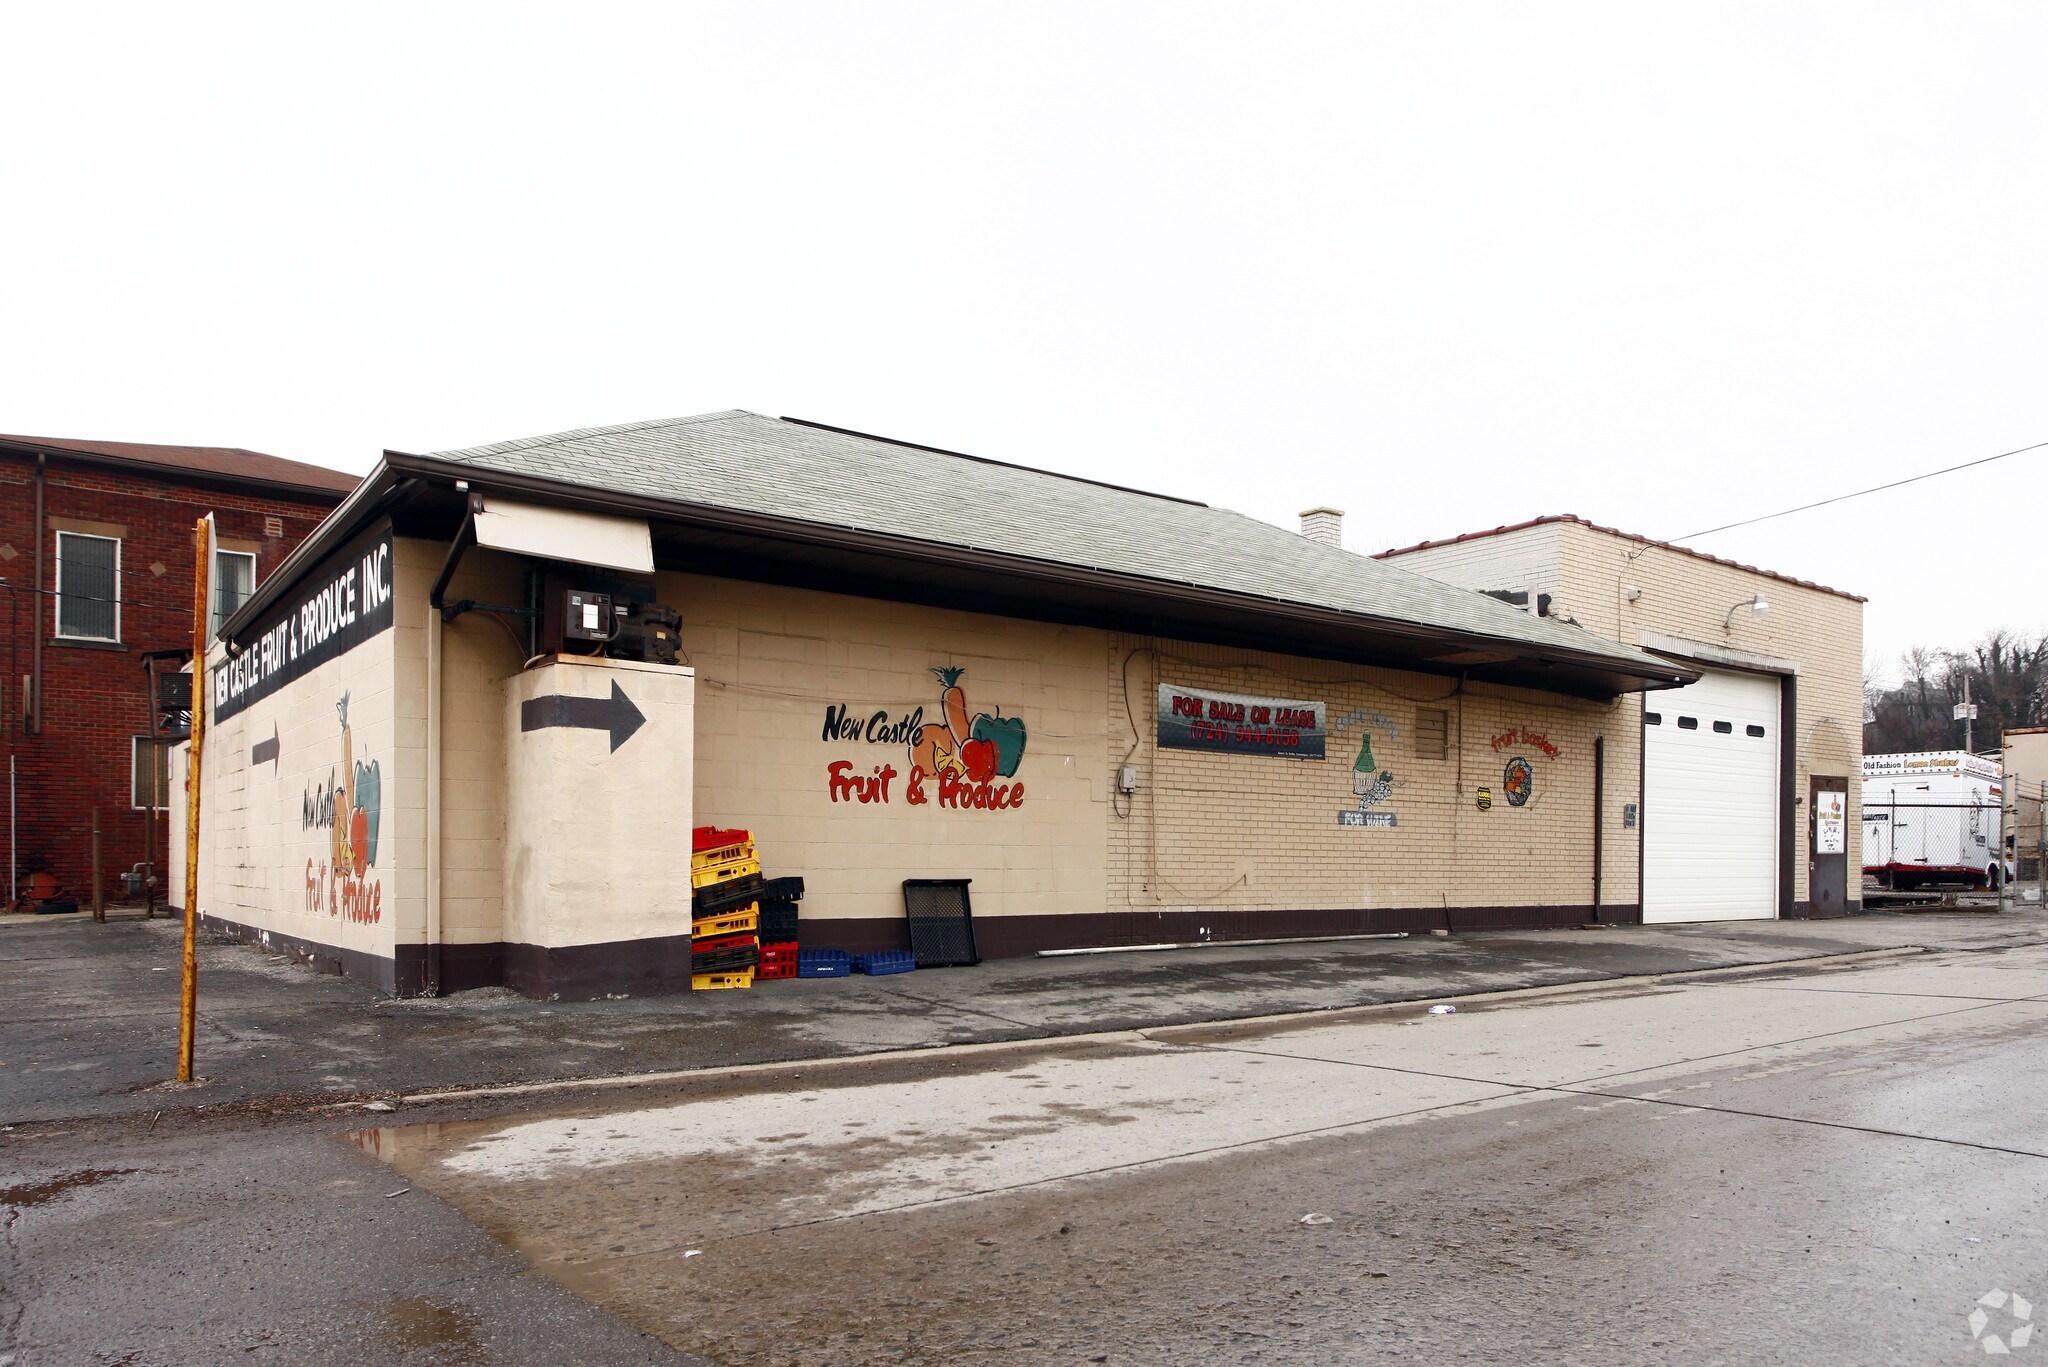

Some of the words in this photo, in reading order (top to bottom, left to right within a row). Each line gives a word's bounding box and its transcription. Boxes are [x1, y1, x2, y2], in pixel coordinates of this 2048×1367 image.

[215, 664, 229, 708] NEW
[229, 641, 258, 698] CASTLE
[261, 619, 288, 680] FRUIT
[290, 612, 298, 661] &
[301, 566, 356, 654] PRODUCE
[362, 542, 391, 615] INC.
[822, 703, 864, 742] New
[865, 706, 924, 747] Castle
[1172, 696, 1204, 718] FOR
[1208, 701, 1246, 722] SALE
[1250, 705, 1271, 725] OR
[1275, 708, 1316, 728] LEASE
[1190, 720, 1229, 744] (724)
[827, 760, 897, 804] Fruit
[906, 764, 928, 806] &
[938, 766, 1025, 811] Produce
[1863, 761, 1875, 770] Old
[1876, 761, 1901, 769] Fashion
[305, 857, 326, 912] Fruit
[329, 857, 338, 918] &
[342, 860, 381, 926] Produce
